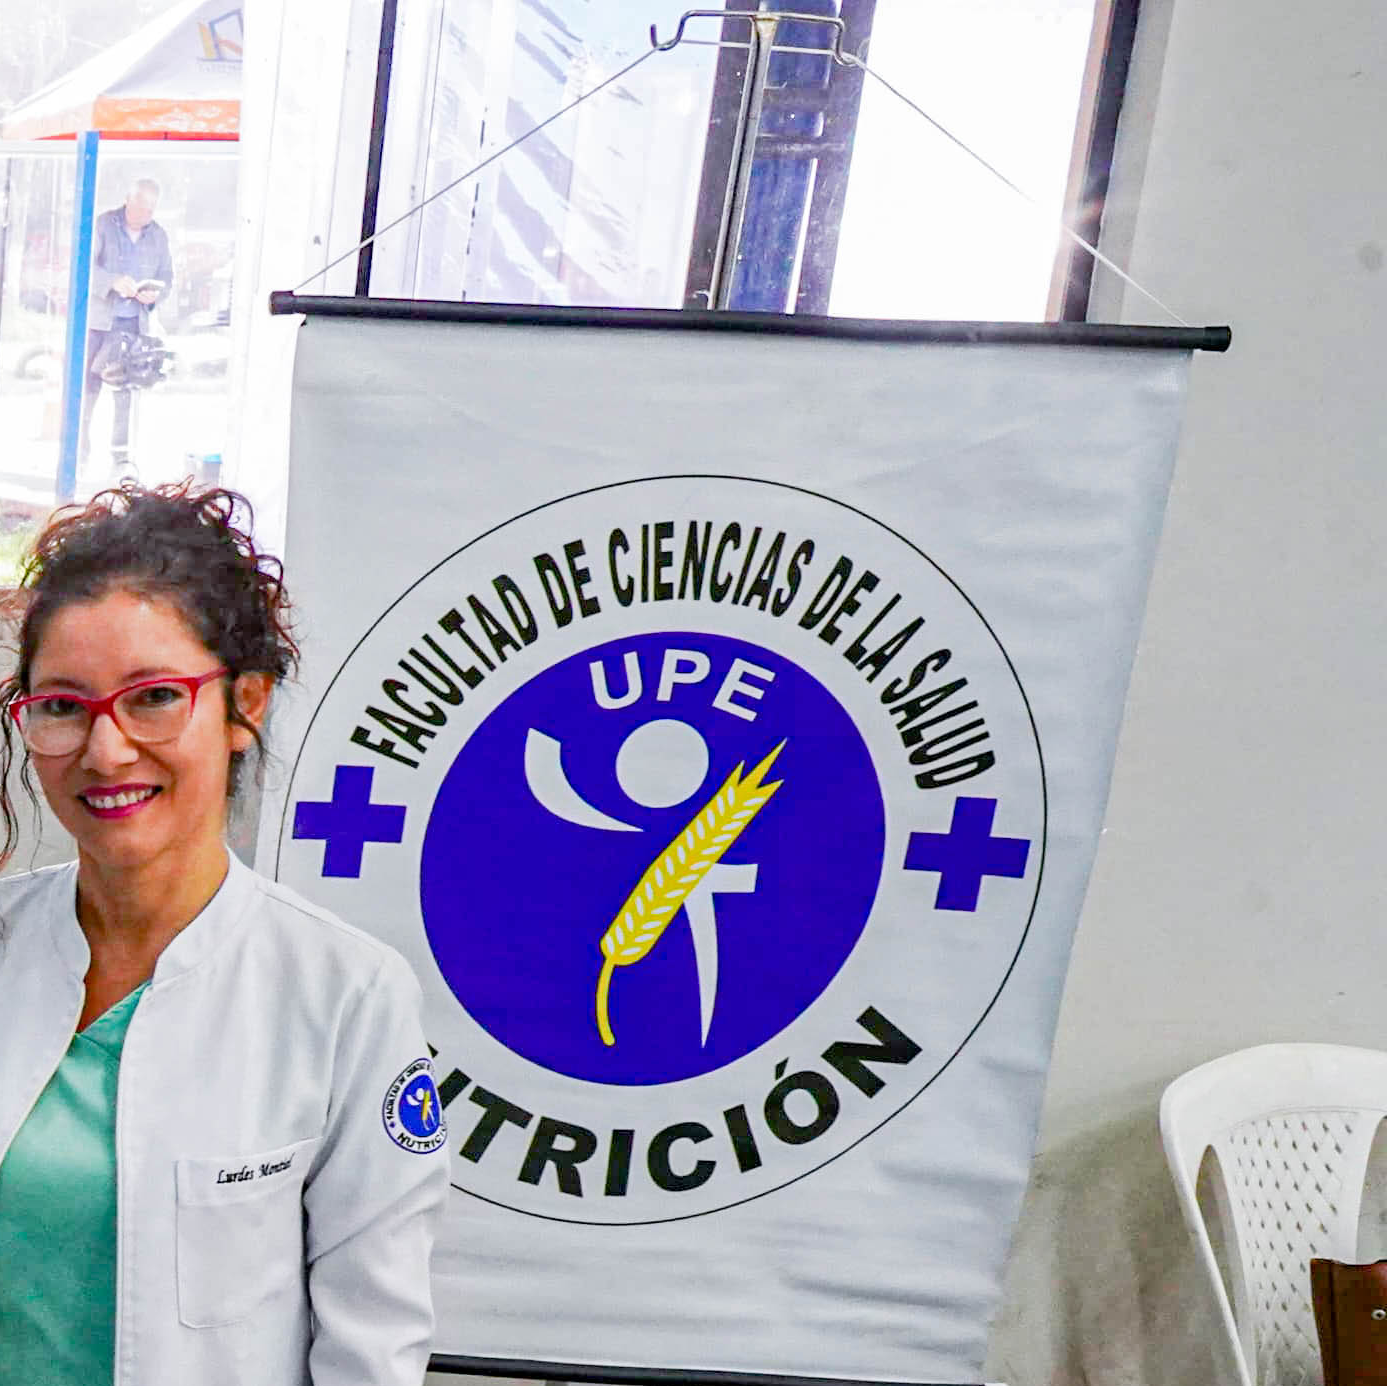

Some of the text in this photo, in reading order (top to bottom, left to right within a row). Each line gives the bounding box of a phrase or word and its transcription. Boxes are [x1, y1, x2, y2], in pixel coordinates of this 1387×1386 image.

[349, 520, 997, 790] FACULTAD DE CIENCIAS DE LA SALUD
[589, 648, 777, 723] UPE
